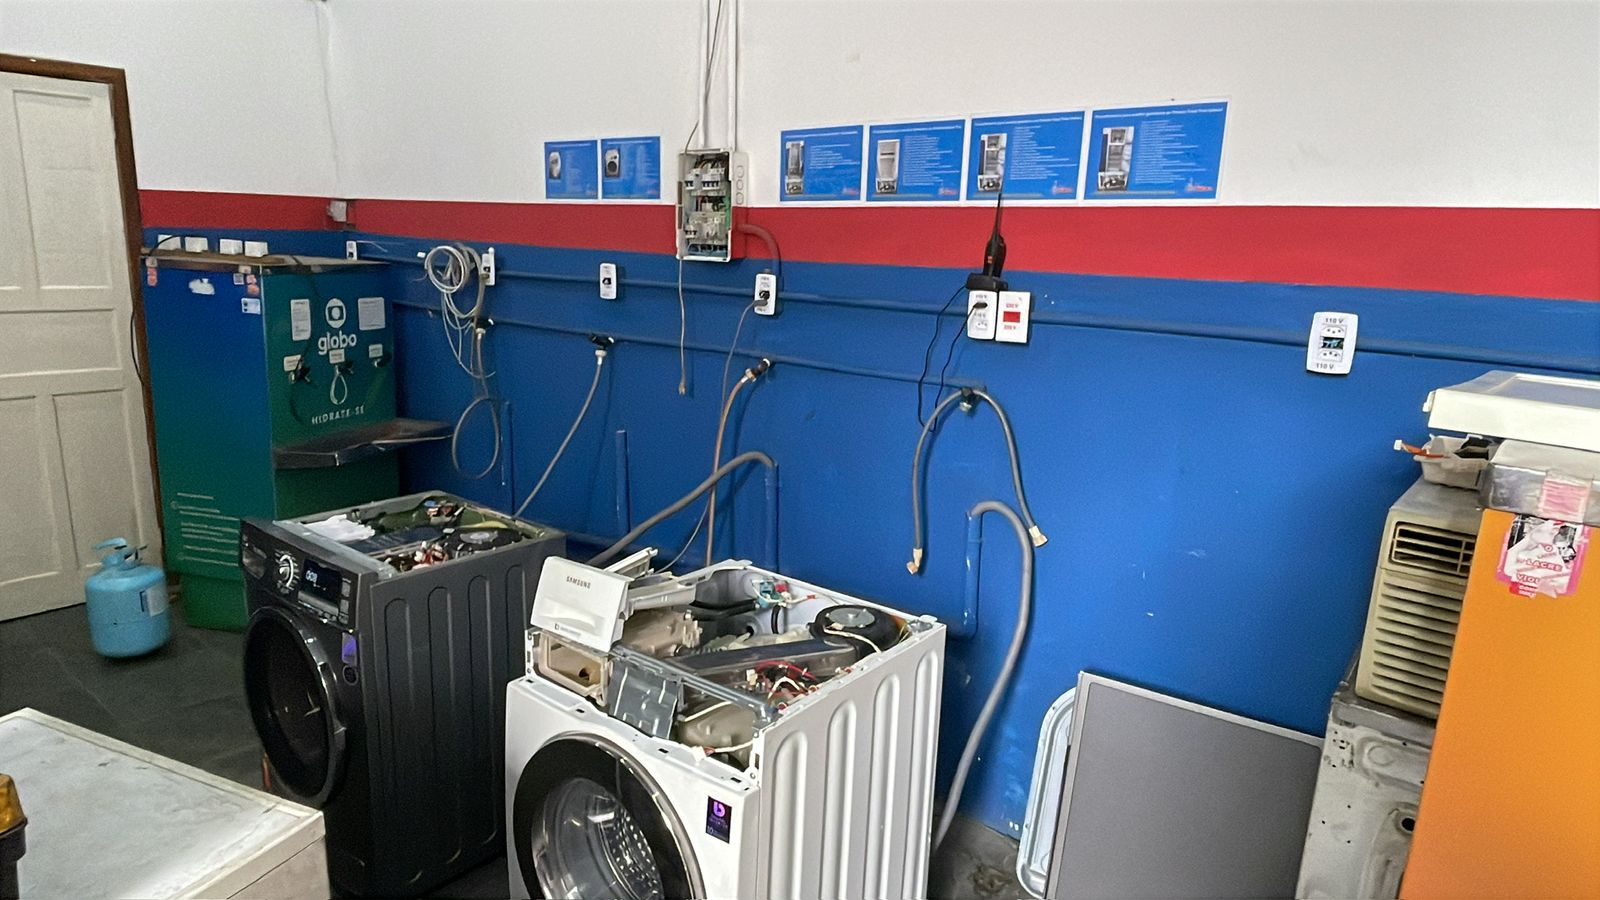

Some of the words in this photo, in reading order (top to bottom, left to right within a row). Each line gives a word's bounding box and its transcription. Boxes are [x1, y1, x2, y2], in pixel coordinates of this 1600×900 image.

[318, 330, 357, 355] globo
[1526, 558, 1562, 572] LACRE
[566, 576, 591, 589] SAMSUNG
